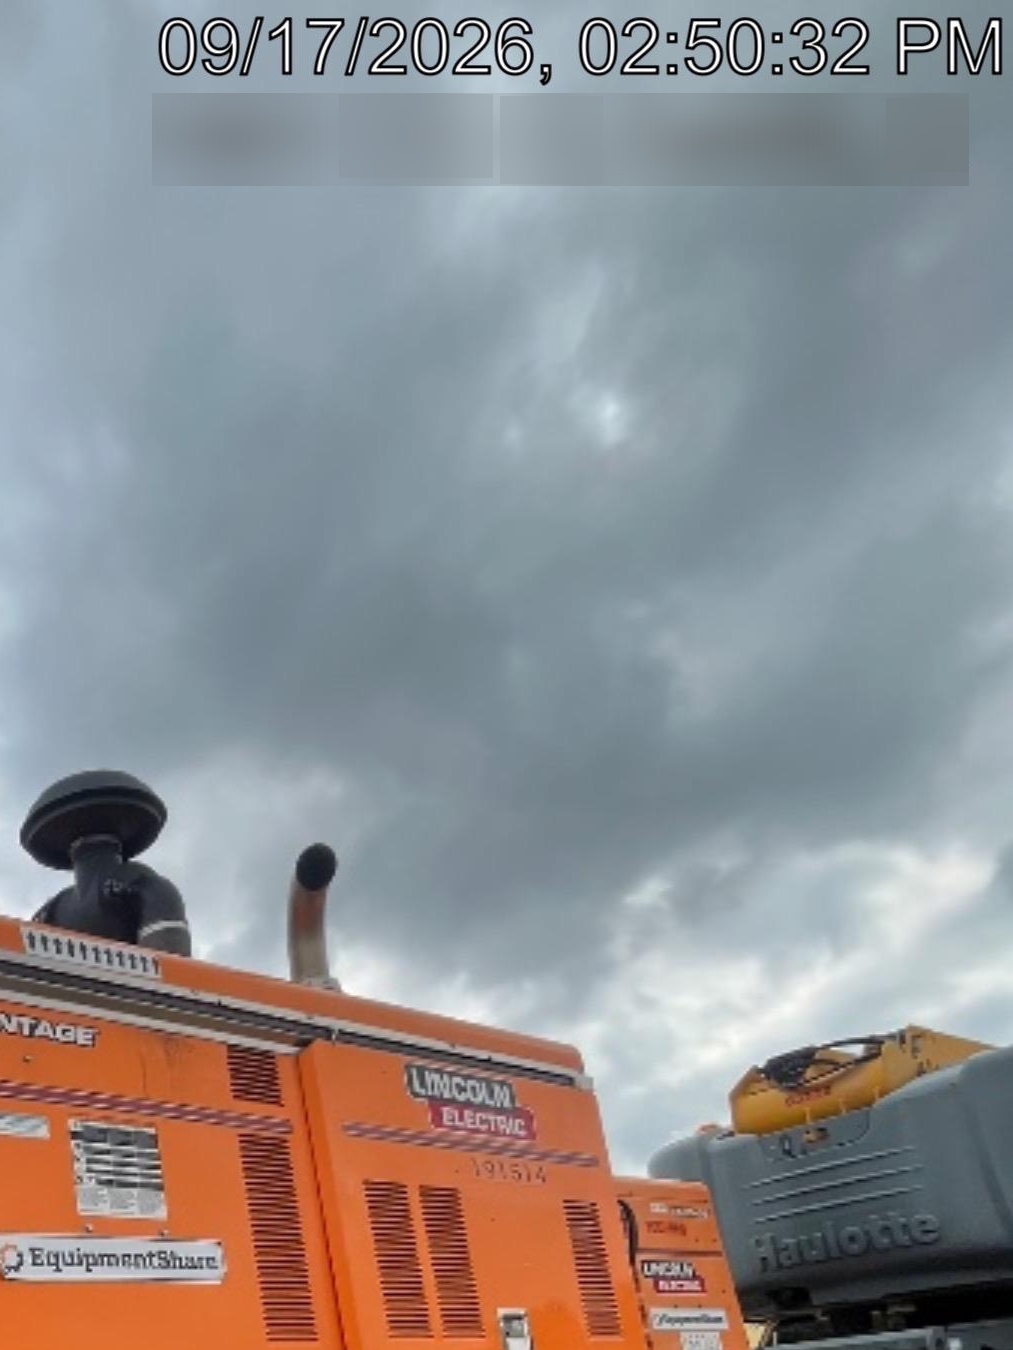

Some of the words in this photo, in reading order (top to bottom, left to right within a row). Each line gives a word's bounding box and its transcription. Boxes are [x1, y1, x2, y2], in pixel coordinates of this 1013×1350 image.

[410, 1067, 513, 1109] LINCOLN
[442, 1106, 526, 1136] ELECTRIC
[28, 1247, 219, 1273] EquipmentShare
[754, 1212, 941, 1274] Haulotte
